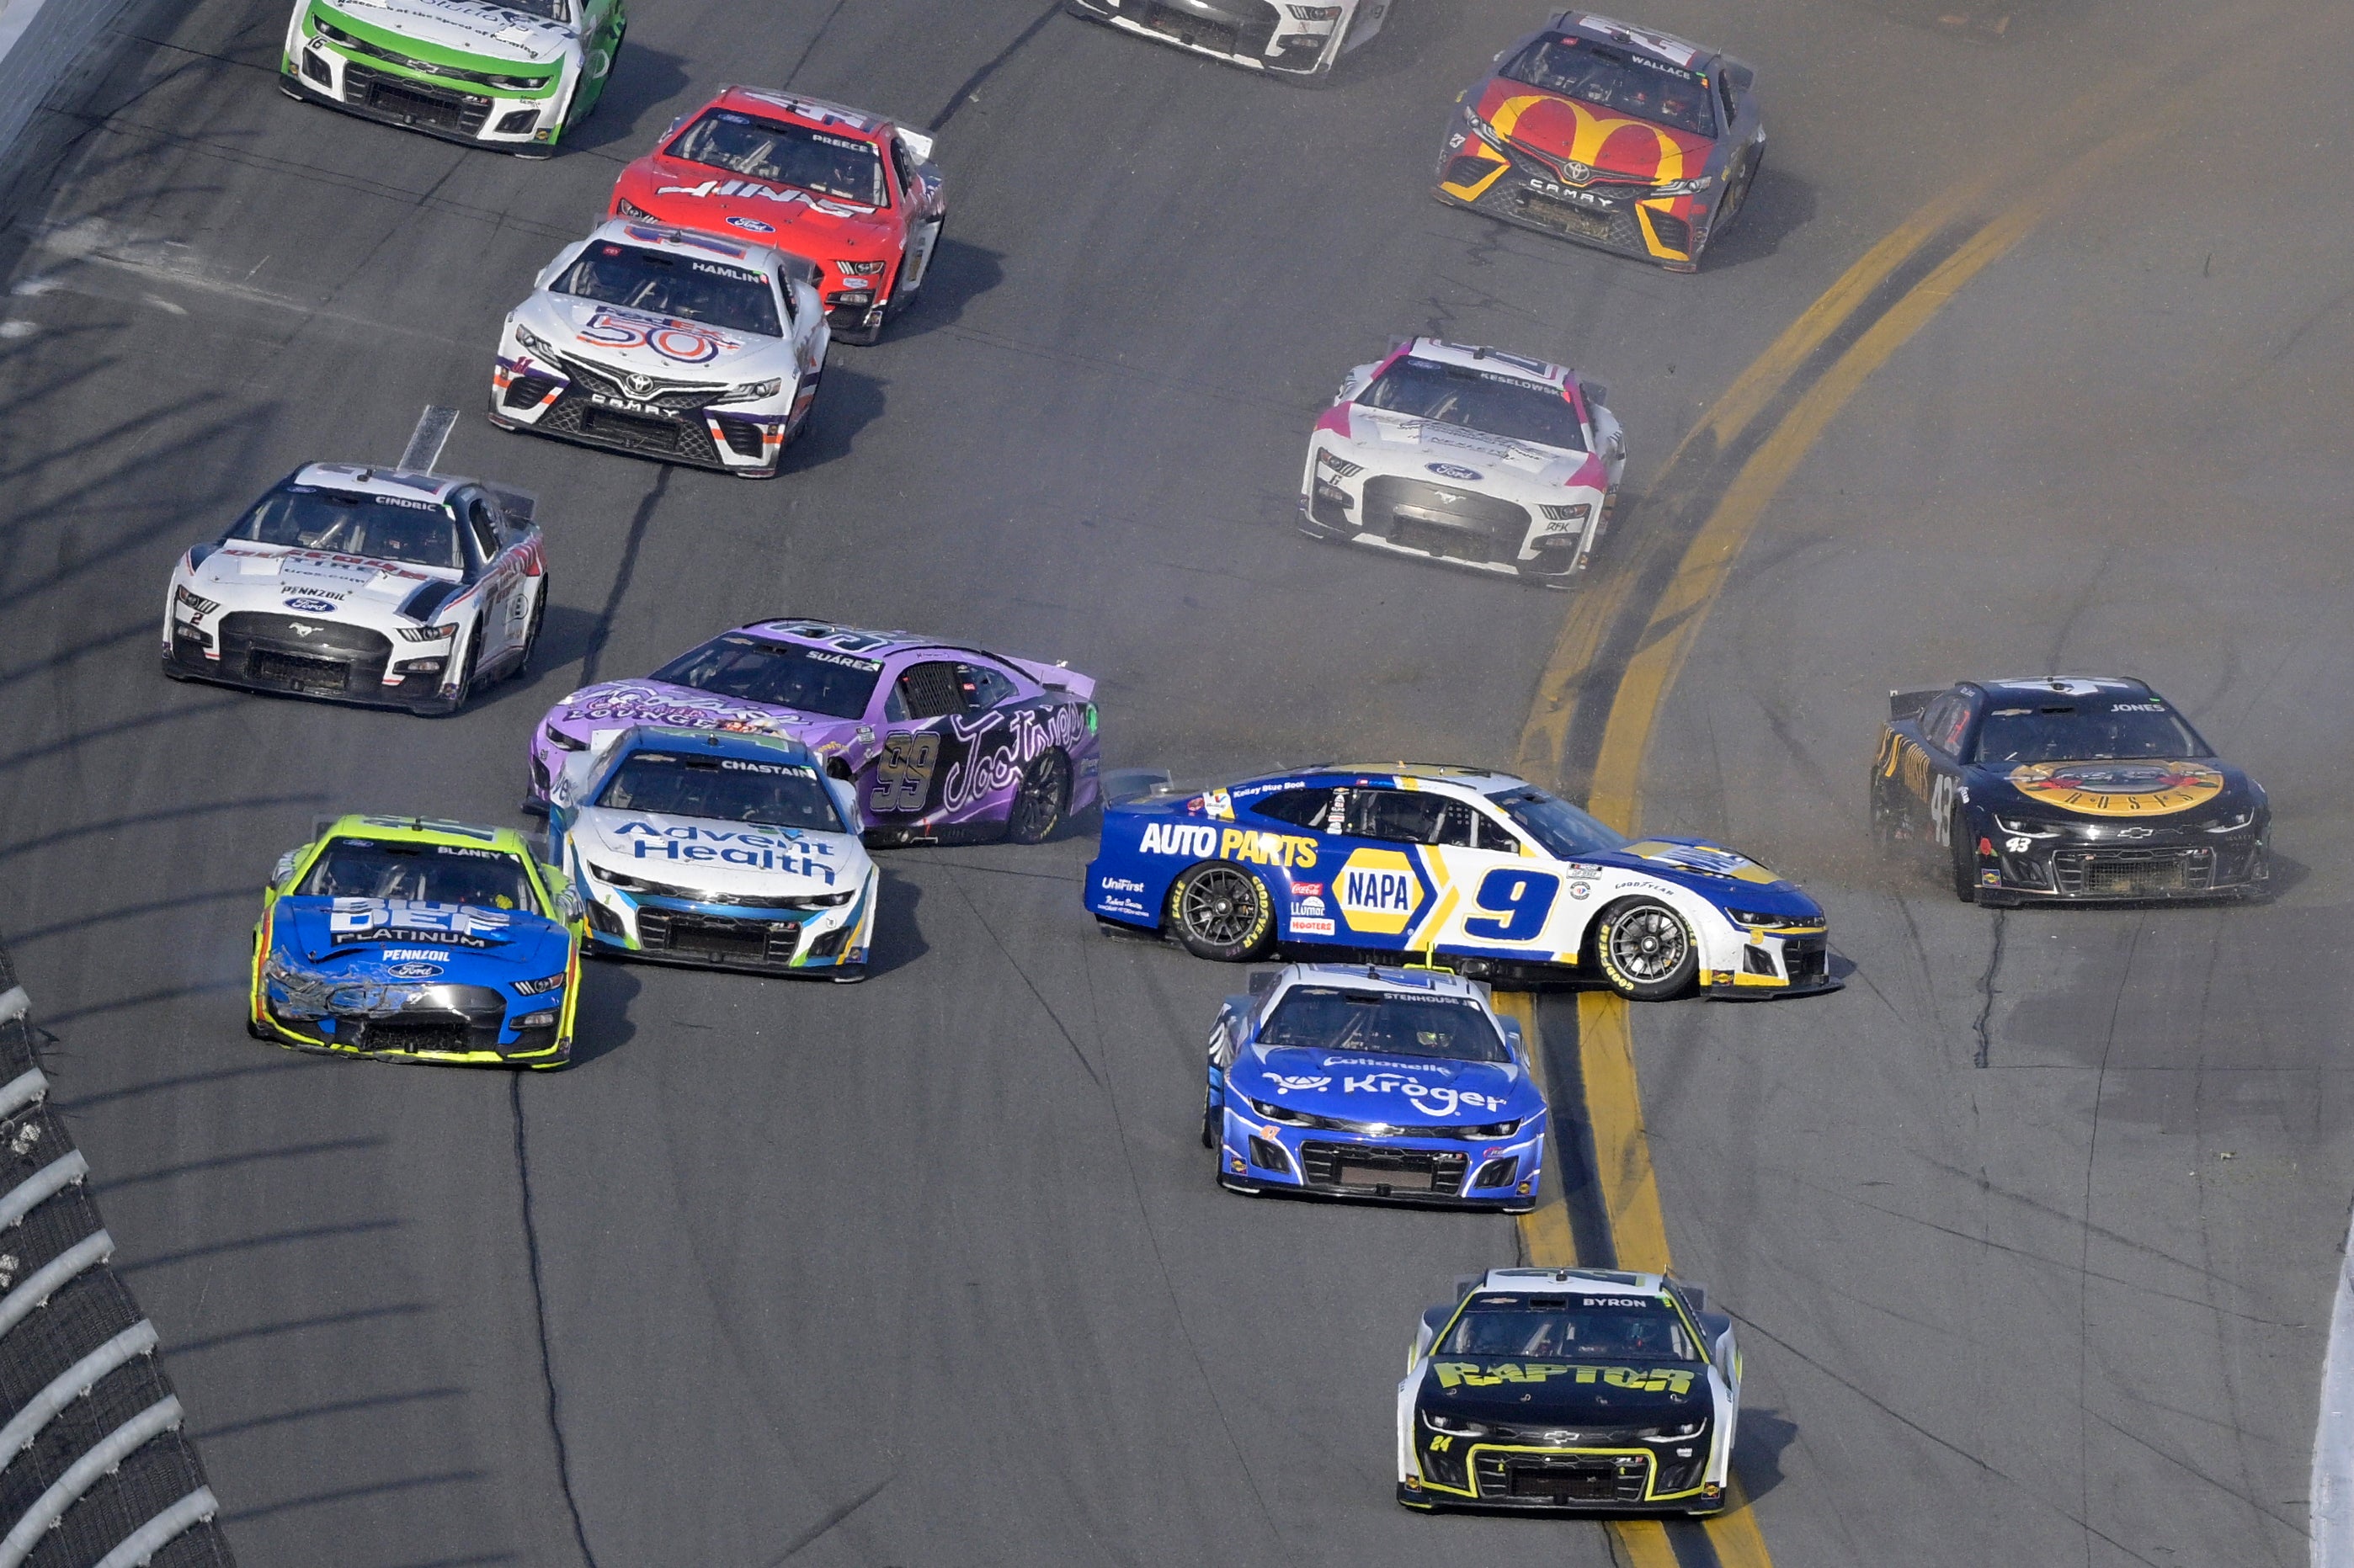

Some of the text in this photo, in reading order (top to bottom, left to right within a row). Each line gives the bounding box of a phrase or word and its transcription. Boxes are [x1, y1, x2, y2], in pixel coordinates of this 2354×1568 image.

[1632, 54, 1691, 80] WALLACE
[812, 133, 871, 153] PREECE
[1449, 132, 1466, 148] 23
[1530, 178, 1614, 207] CAMRY
[691, 261, 763, 284] HAMLIN
[576, 313, 719, 364] 50
[1480, 372, 1563, 397] KESELOWSK
[591, 393, 680, 417] CAMRY
[1434, 463, 1475, 480] Ford
[375, 495, 437, 513] CINDRIC
[280, 584, 347, 602] PENNZOIL
[290, 598, 329, 613] Ford
[189, 611, 205, 626] 2
[2110, 704, 2166, 712] JONES
[721, 760, 812, 779] CHASTAIN
[870, 729, 941, 813] 99
[1233, 786, 1261, 799] Kelley
[1262, 784, 1283, 792] Blue
[614, 821, 835, 857] Advent
[1138, 821, 1319, 869] AUTO PARTS
[2005, 837, 2032, 853] 43
[437, 845, 503, 861] BLANEY
[634, 839, 837, 887] Health
[1101, 876, 1145, 893] UniFirst
[1347, 871, 1410, 912] NAPA
[1171, 880, 1187, 920] EAGLE
[1461, 864, 1564, 945] 9
[1242, 874, 1271, 949] GOODYEAR
[1292, 921, 1332, 932] HOOTERS
[336, 927, 486, 949] PLATINUM
[382, 949, 450, 962] PENNZOIL
[1599, 923, 1636, 991] GOODYEAR
[396, 963, 434, 976] Ford
[1383, 991, 1459, 1006] STENHOUSE
[1323, 1055, 1454, 1076] Cottonelle
[1343, 1072, 1509, 1118] Kroger
[1583, 1297, 1647, 1308] BYRON
[1433, 1362, 1696, 1395] RAPTOR
[1430, 1435, 1453, 1453] 24
